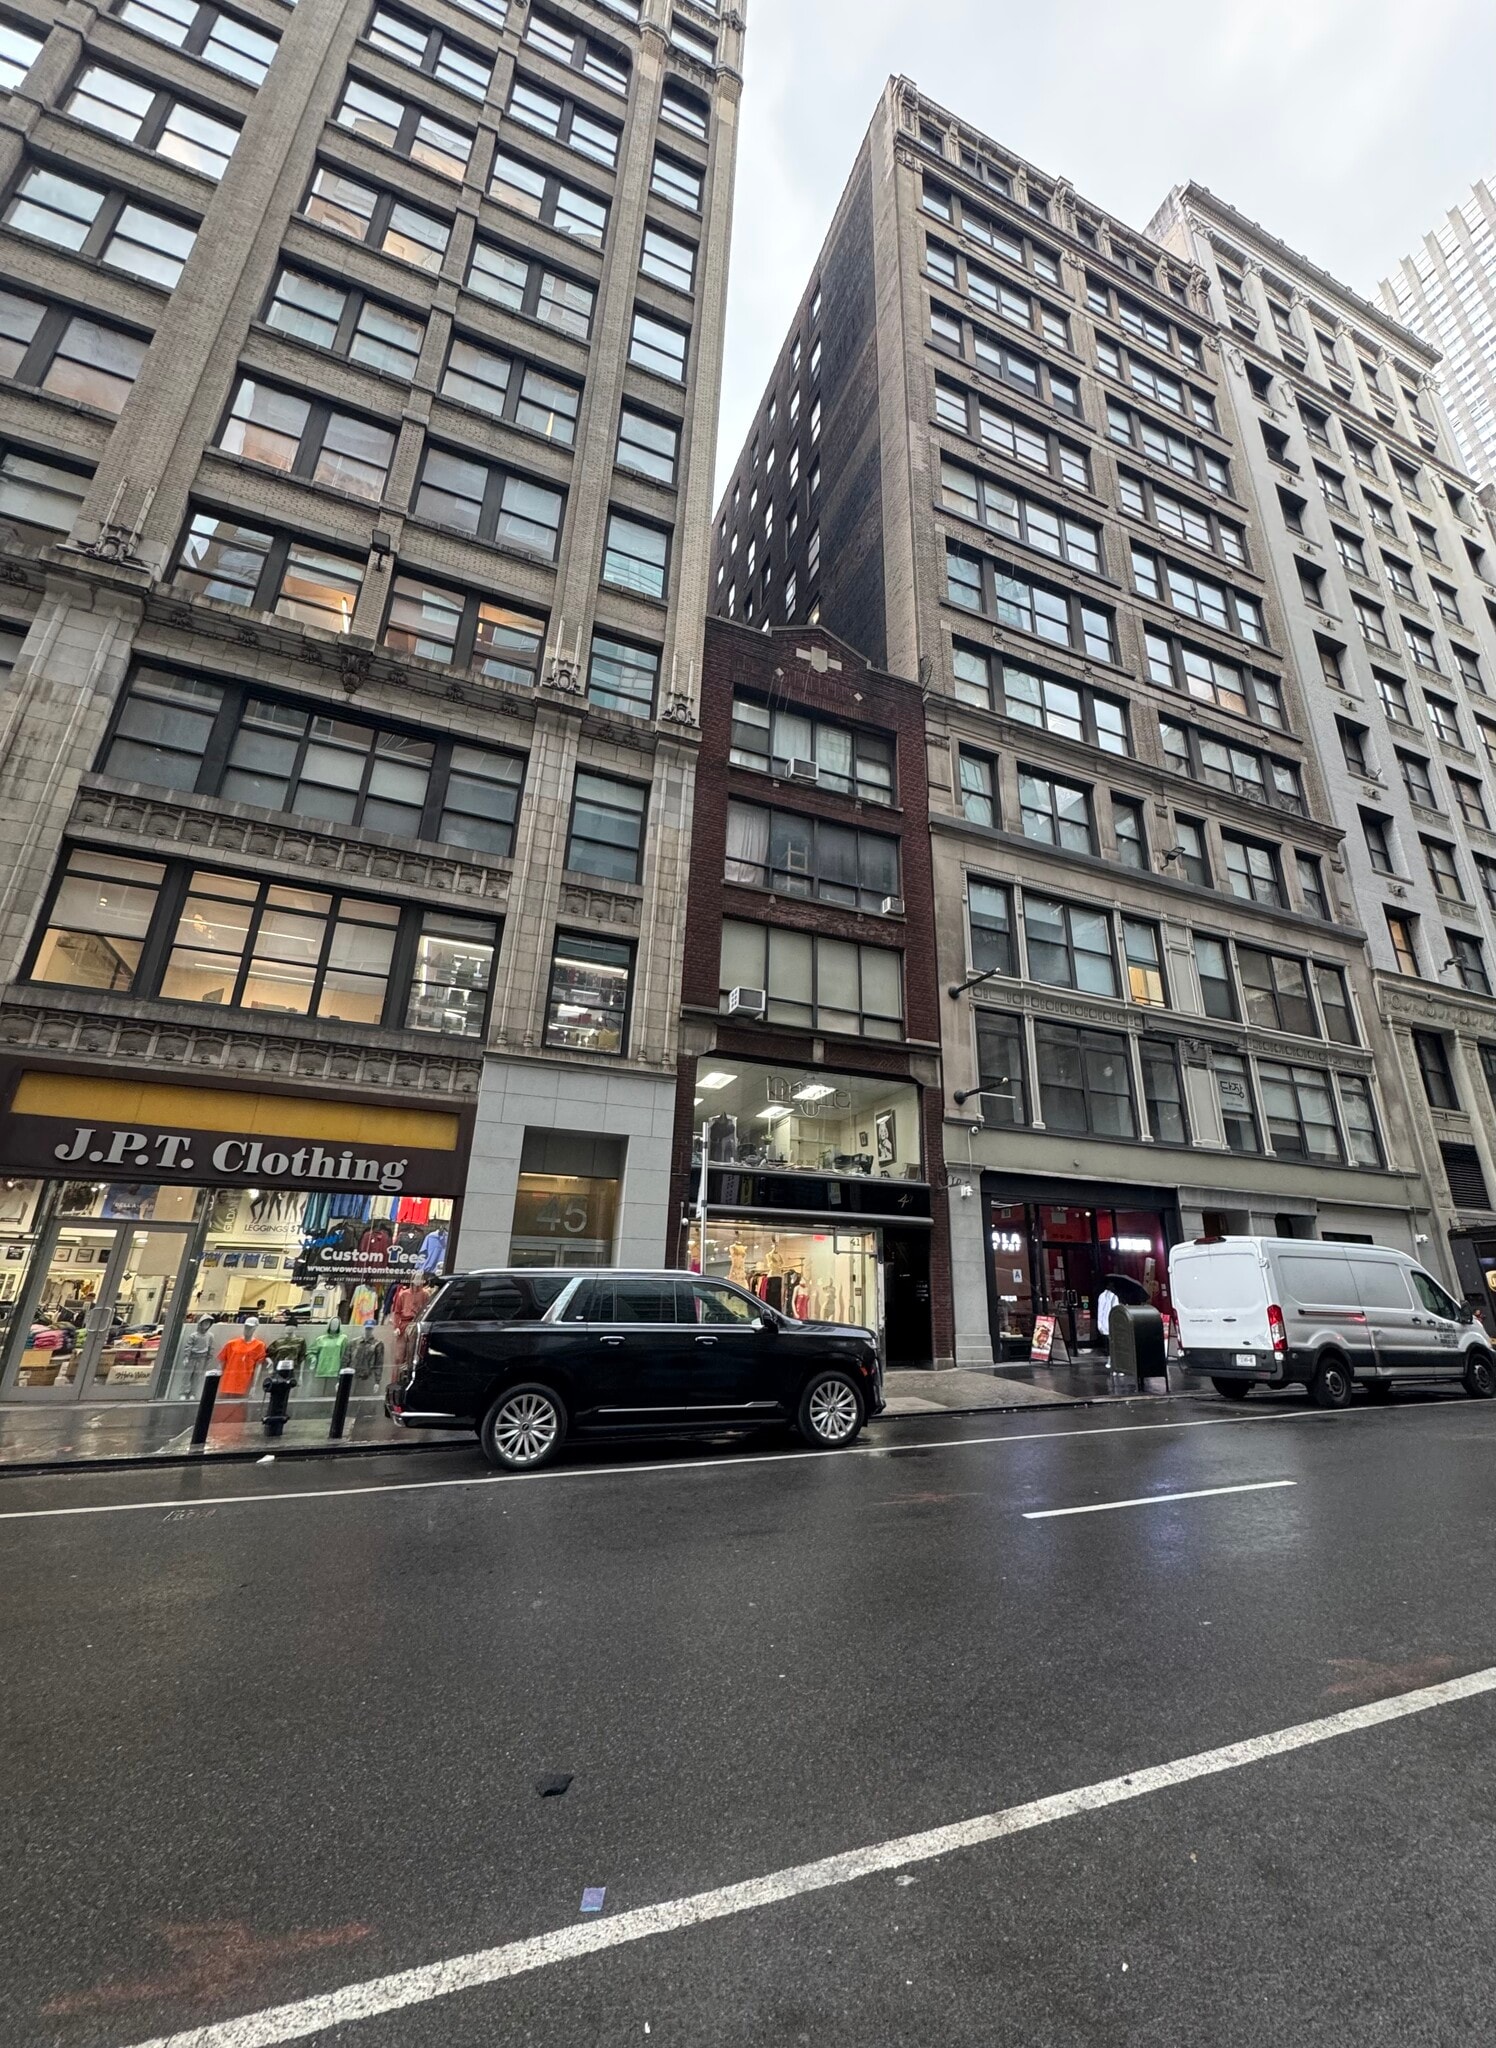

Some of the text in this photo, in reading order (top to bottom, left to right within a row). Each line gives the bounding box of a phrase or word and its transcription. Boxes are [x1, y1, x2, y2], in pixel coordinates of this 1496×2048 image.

[55, 1128, 408, 1191] J.P.T. Clothing
[223, 1200, 239, 1232] GILDAN
[536, 1195, 588, 1233] 45
[244, 1224, 288, 1233] LEGGINGS
[850, 1238, 860, 1246] 41
[320, 1247, 383, 1262] Custom
[307, 1265, 425, 1275] www.wowcustomtees.com
